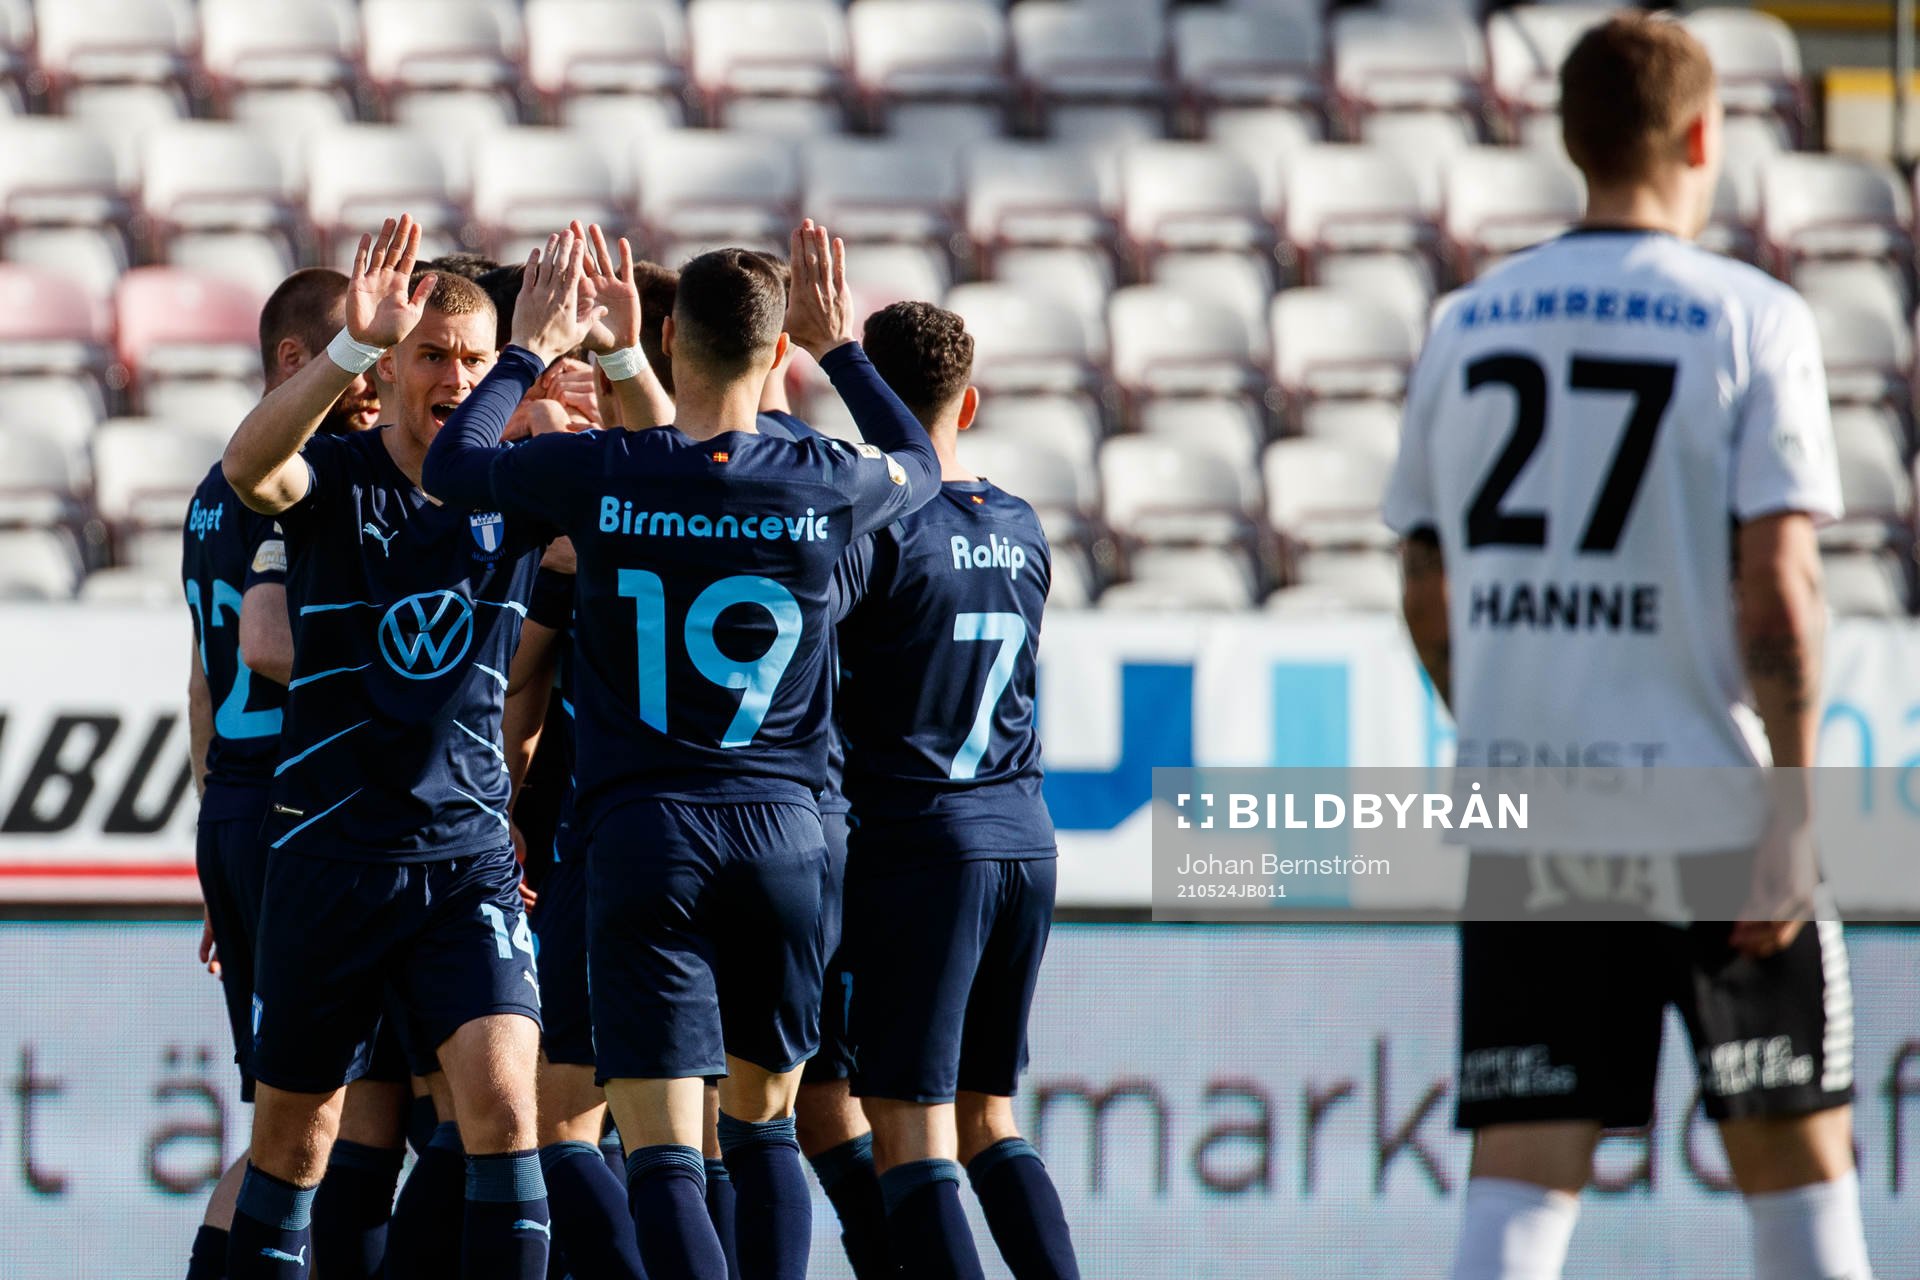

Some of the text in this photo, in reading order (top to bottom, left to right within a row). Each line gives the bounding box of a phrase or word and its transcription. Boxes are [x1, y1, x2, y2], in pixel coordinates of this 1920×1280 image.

[1464, 350, 1679, 556] 27
[599, 496, 830, 543] Birmancevic
[950, 535, 1026, 579] Rakip
[1469, 582, 1662, 633] HANNE
[617, 568, 803, 749] 19
[949, 612, 1027, 780] 7
[0, 714, 191, 834] BU
[480, 903, 538, 973] 14
